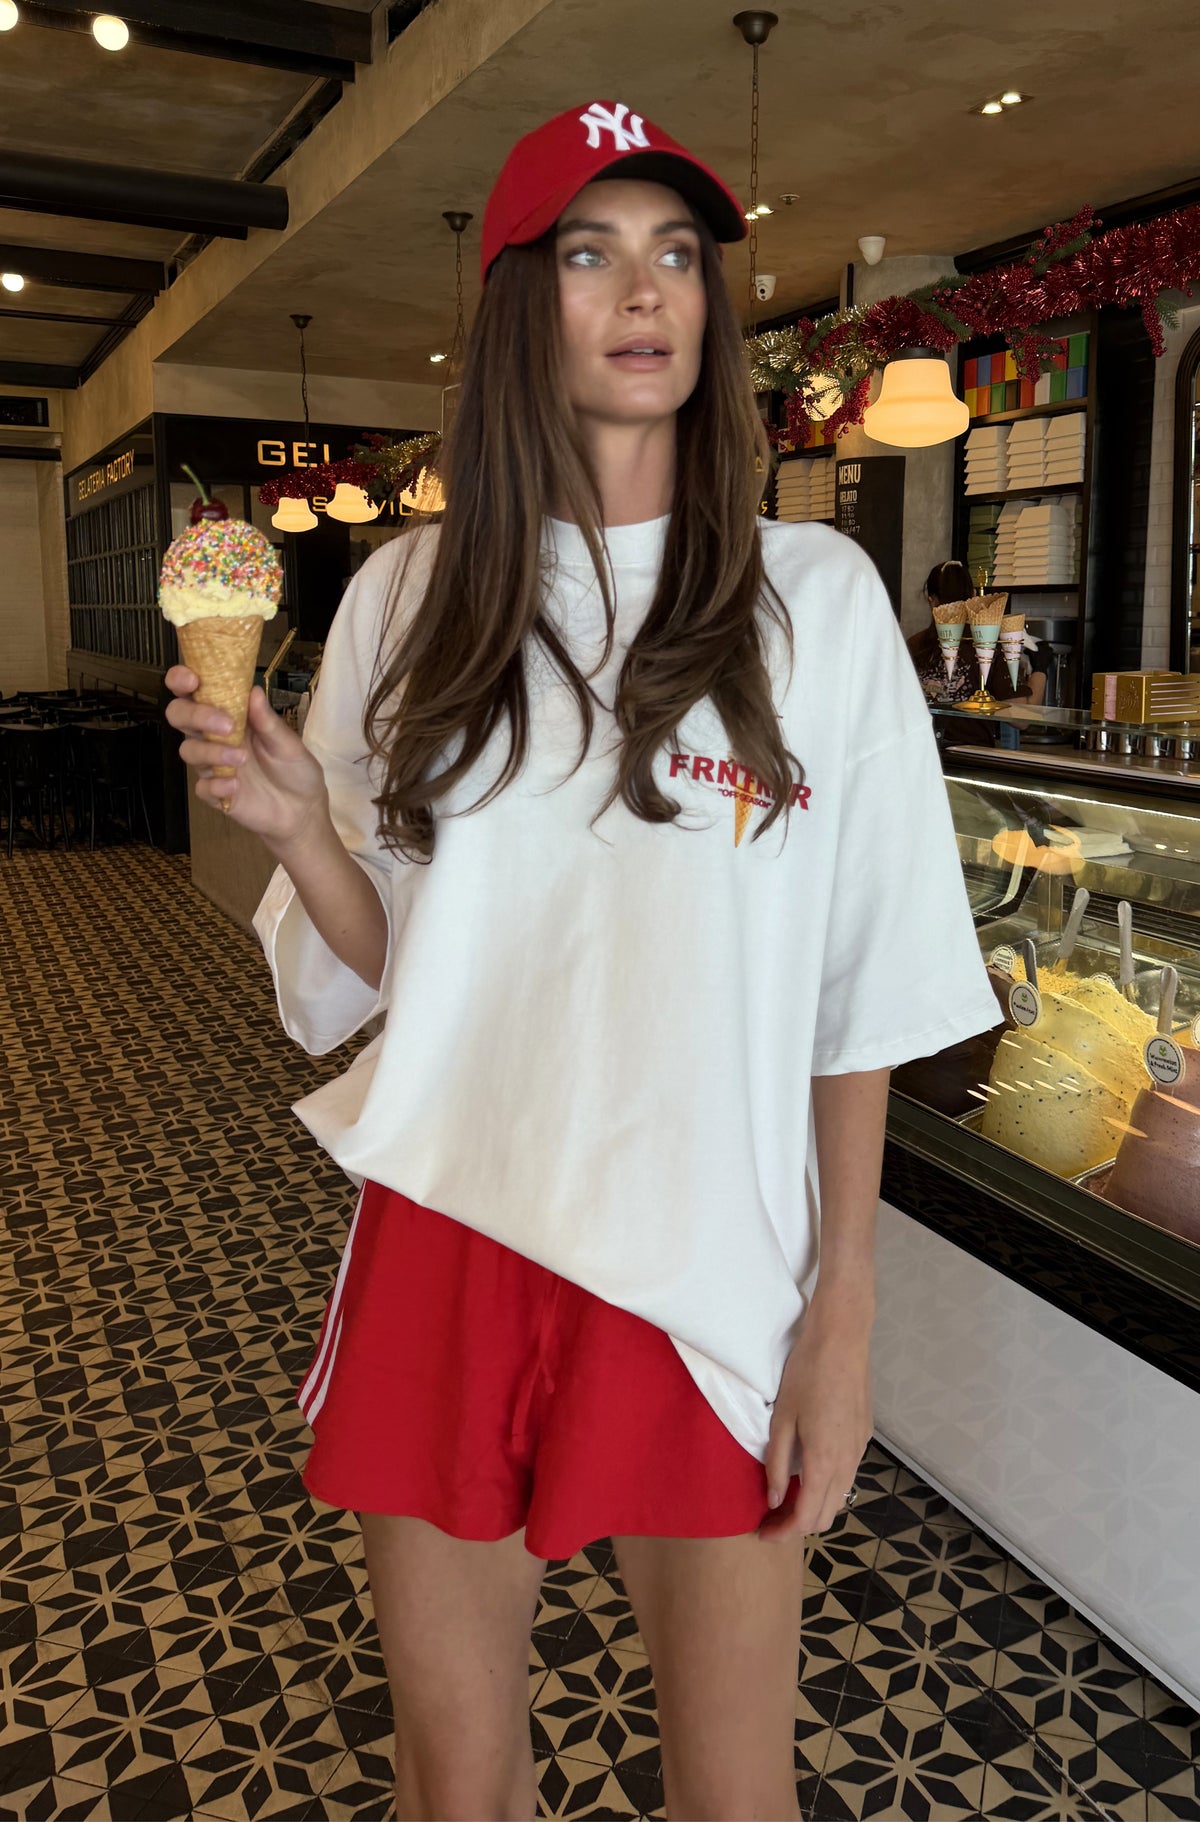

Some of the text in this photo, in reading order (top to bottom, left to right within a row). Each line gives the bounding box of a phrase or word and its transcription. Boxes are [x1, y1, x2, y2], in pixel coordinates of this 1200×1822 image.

[579, 103, 651, 151] NY
[106, 448, 135, 487] FACTORY
[838, 464, 861, 485] MENU
